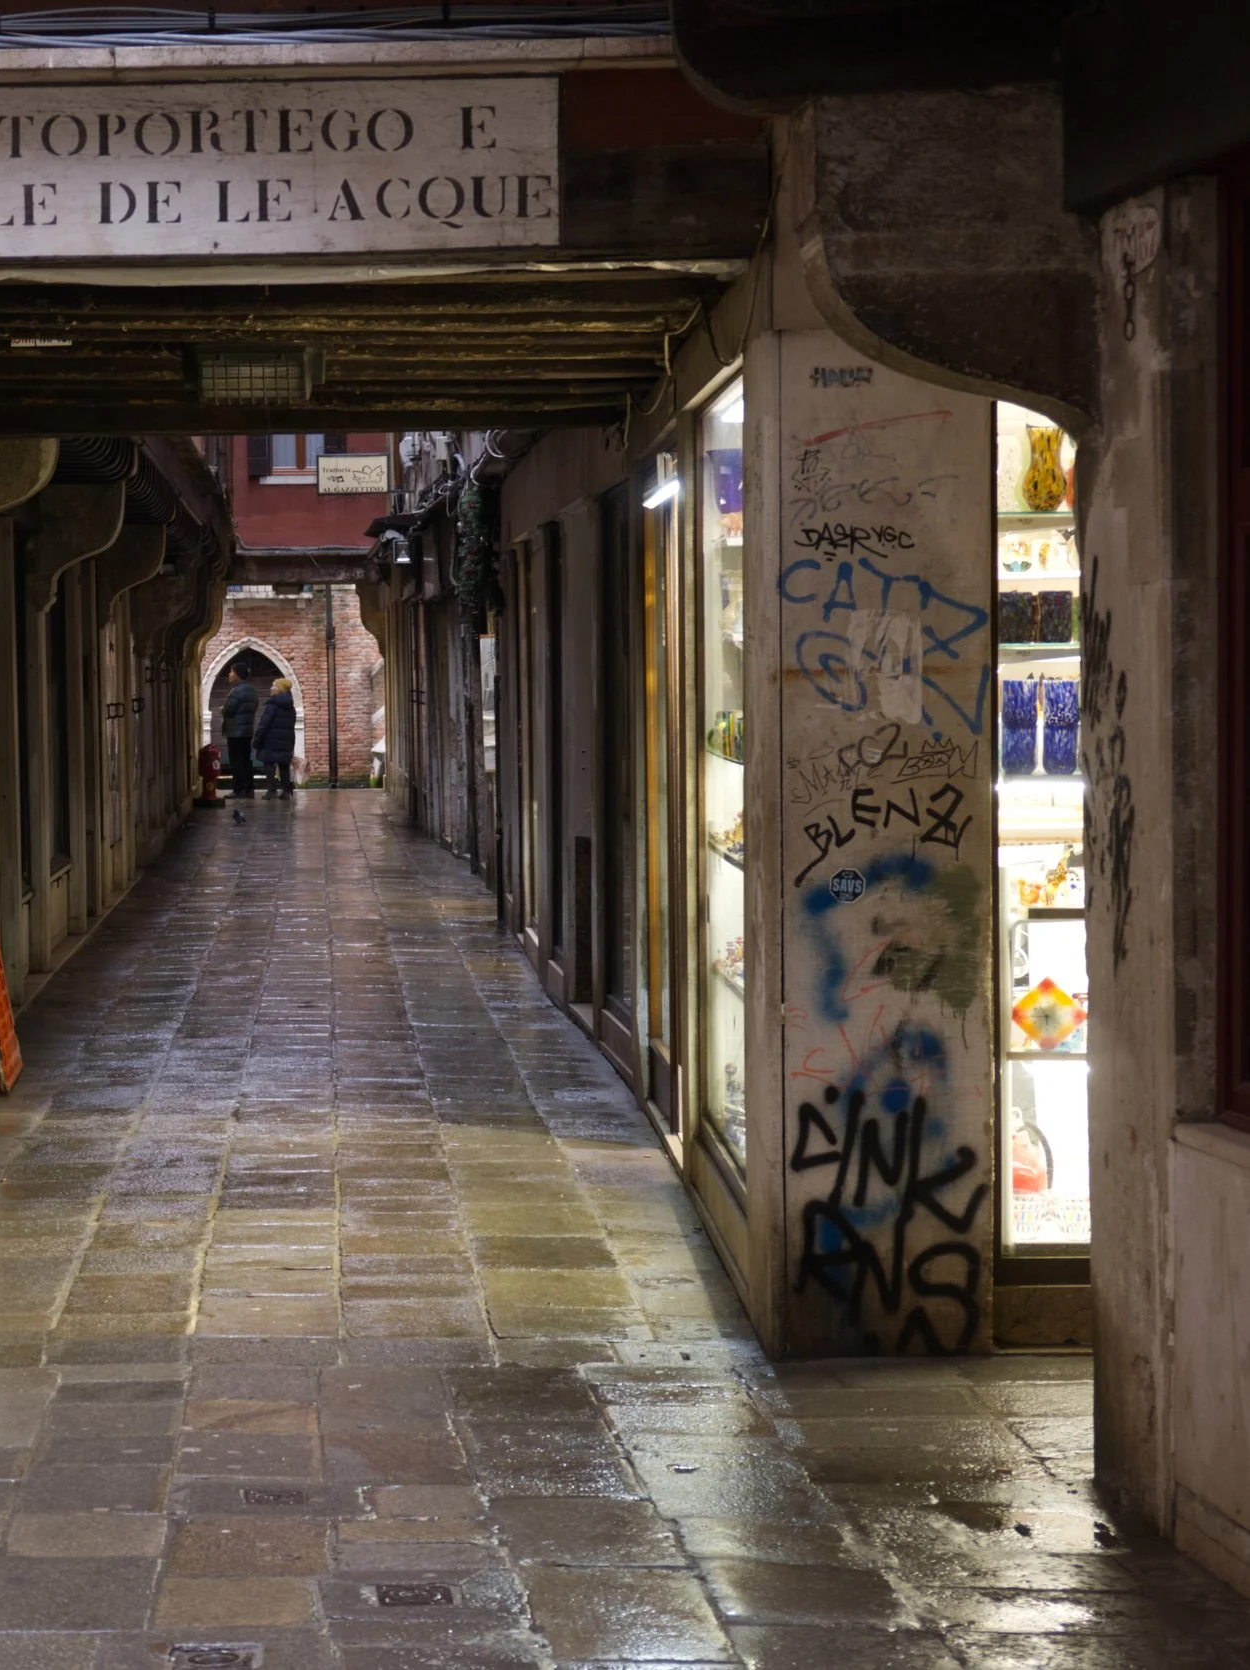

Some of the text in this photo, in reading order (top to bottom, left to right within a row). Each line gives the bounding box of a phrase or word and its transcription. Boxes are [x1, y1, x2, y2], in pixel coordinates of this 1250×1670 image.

[461, 105, 496, 149] E
[98, 181, 182, 224] DE
[217, 179, 292, 222] LE
[327, 175, 552, 229] ACQUE
